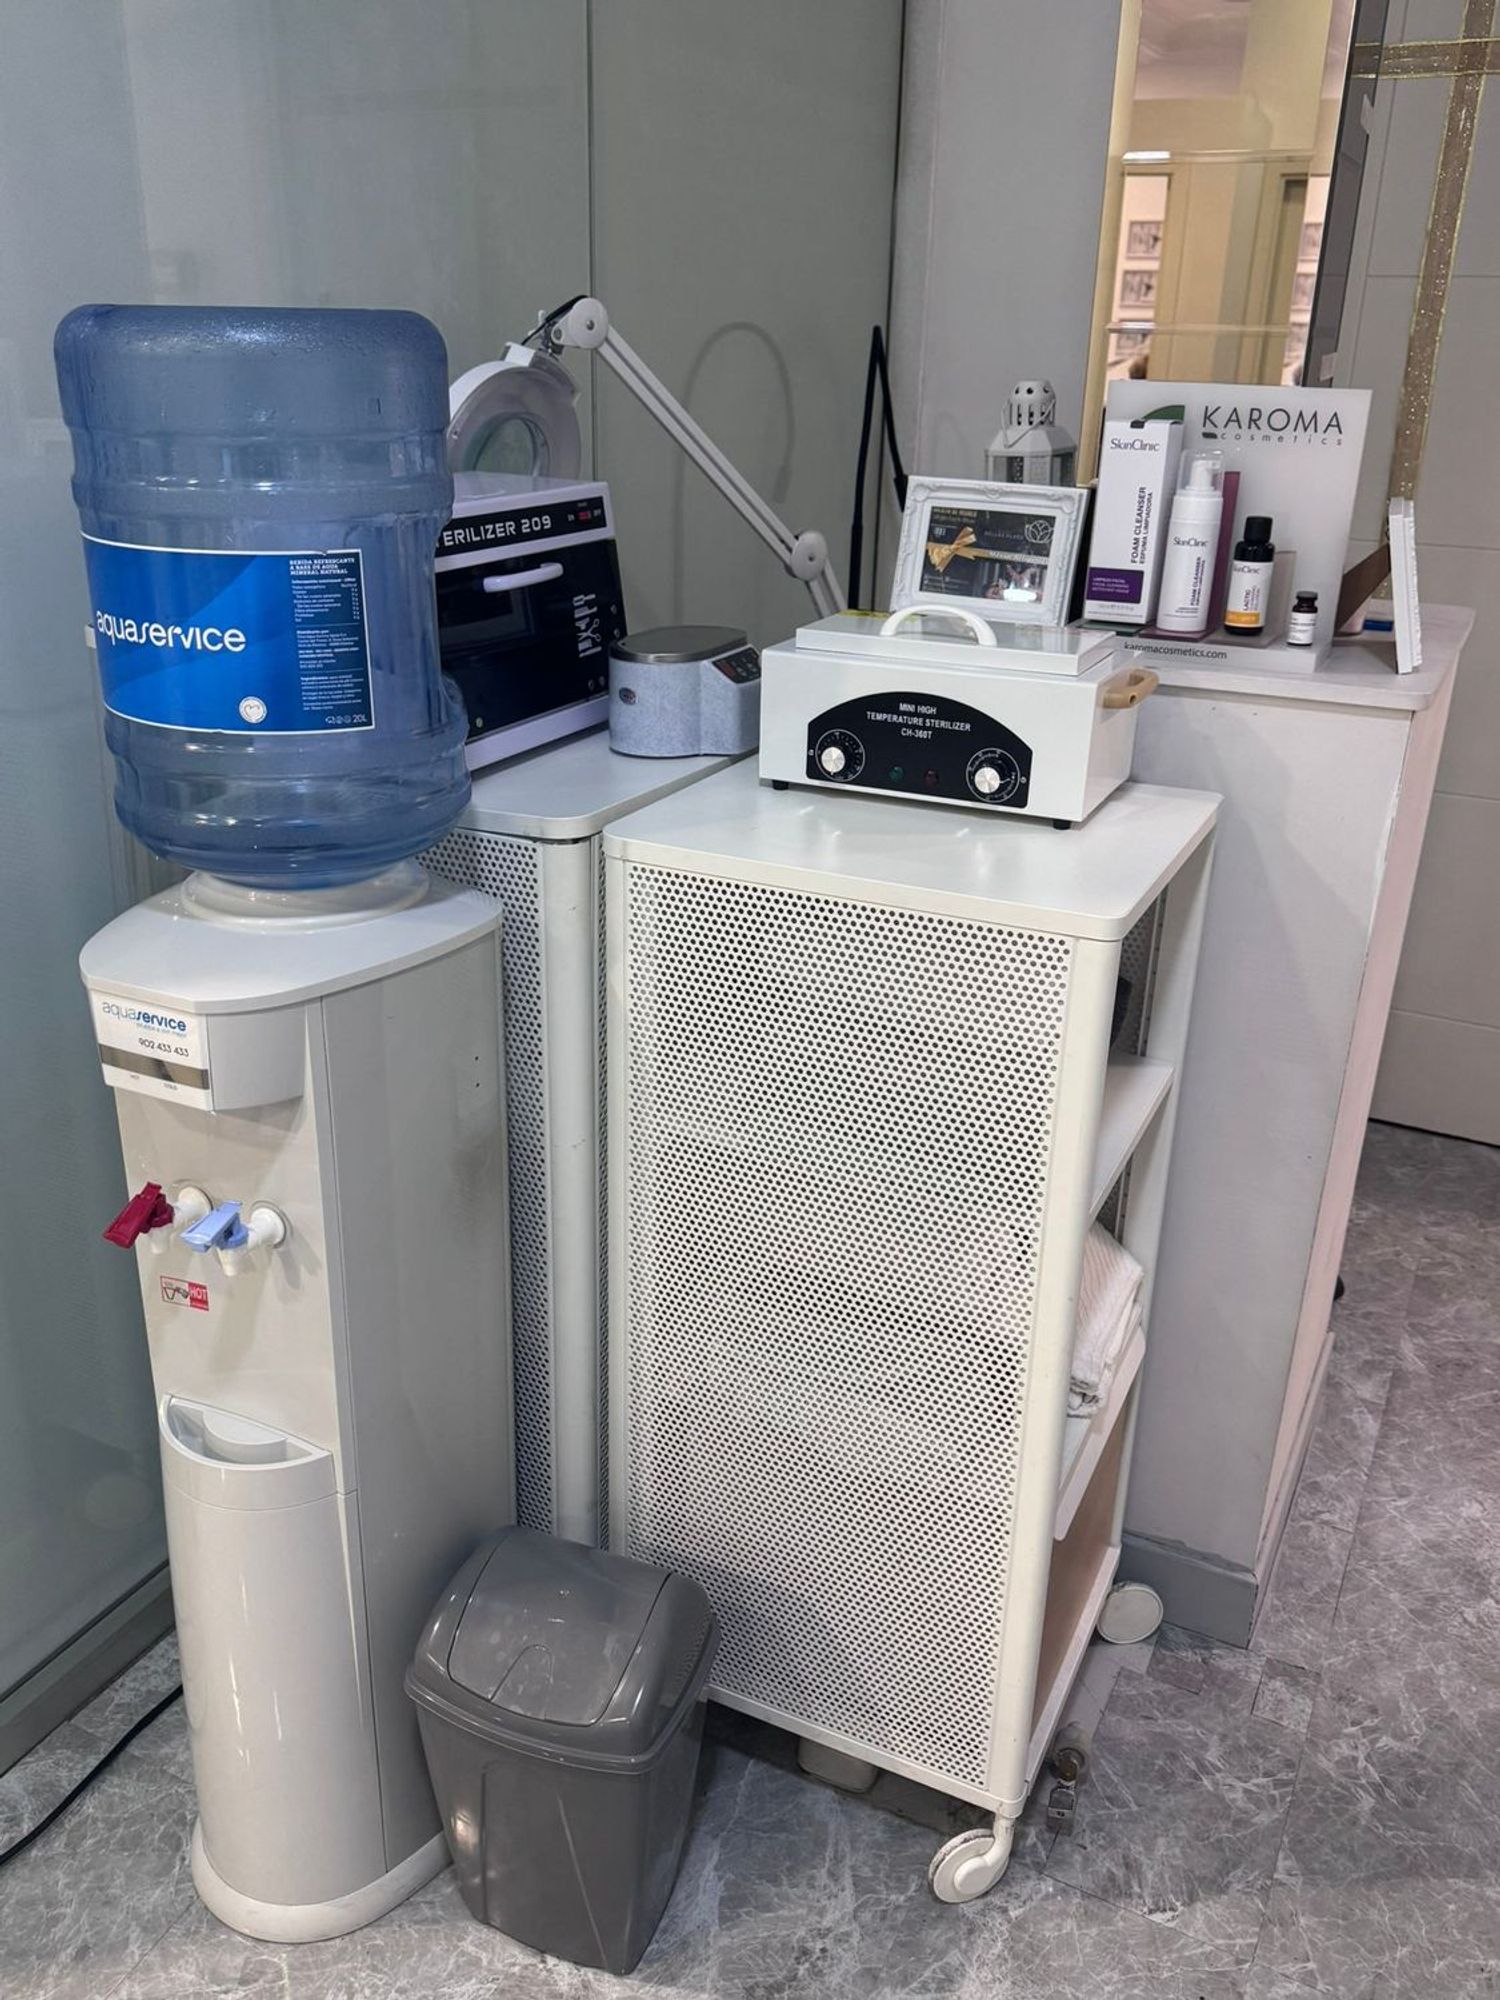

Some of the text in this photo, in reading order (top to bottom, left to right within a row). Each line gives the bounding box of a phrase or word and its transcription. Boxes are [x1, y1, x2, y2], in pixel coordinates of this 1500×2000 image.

[1202, 405, 1342, 434] KAROMA
[1110, 437, 1160, 451] SkinClinic
[1220, 432, 1342, 446] cosmetics
[435, 515, 552, 548] ERILIZER 209
[1130, 486, 1146, 564] FOAM CLEANSER
[96, 610, 246, 652] aquaservice
[899, 702, 937, 715] MINI HIGH
[866, 710, 971, 732] TEMPERATURE STERILIZER
[102, 1001, 187, 1032] aquaservice
[138, 1037, 189, 1058] 902 433 433
[189, 1286, 207, 1300] HOT
